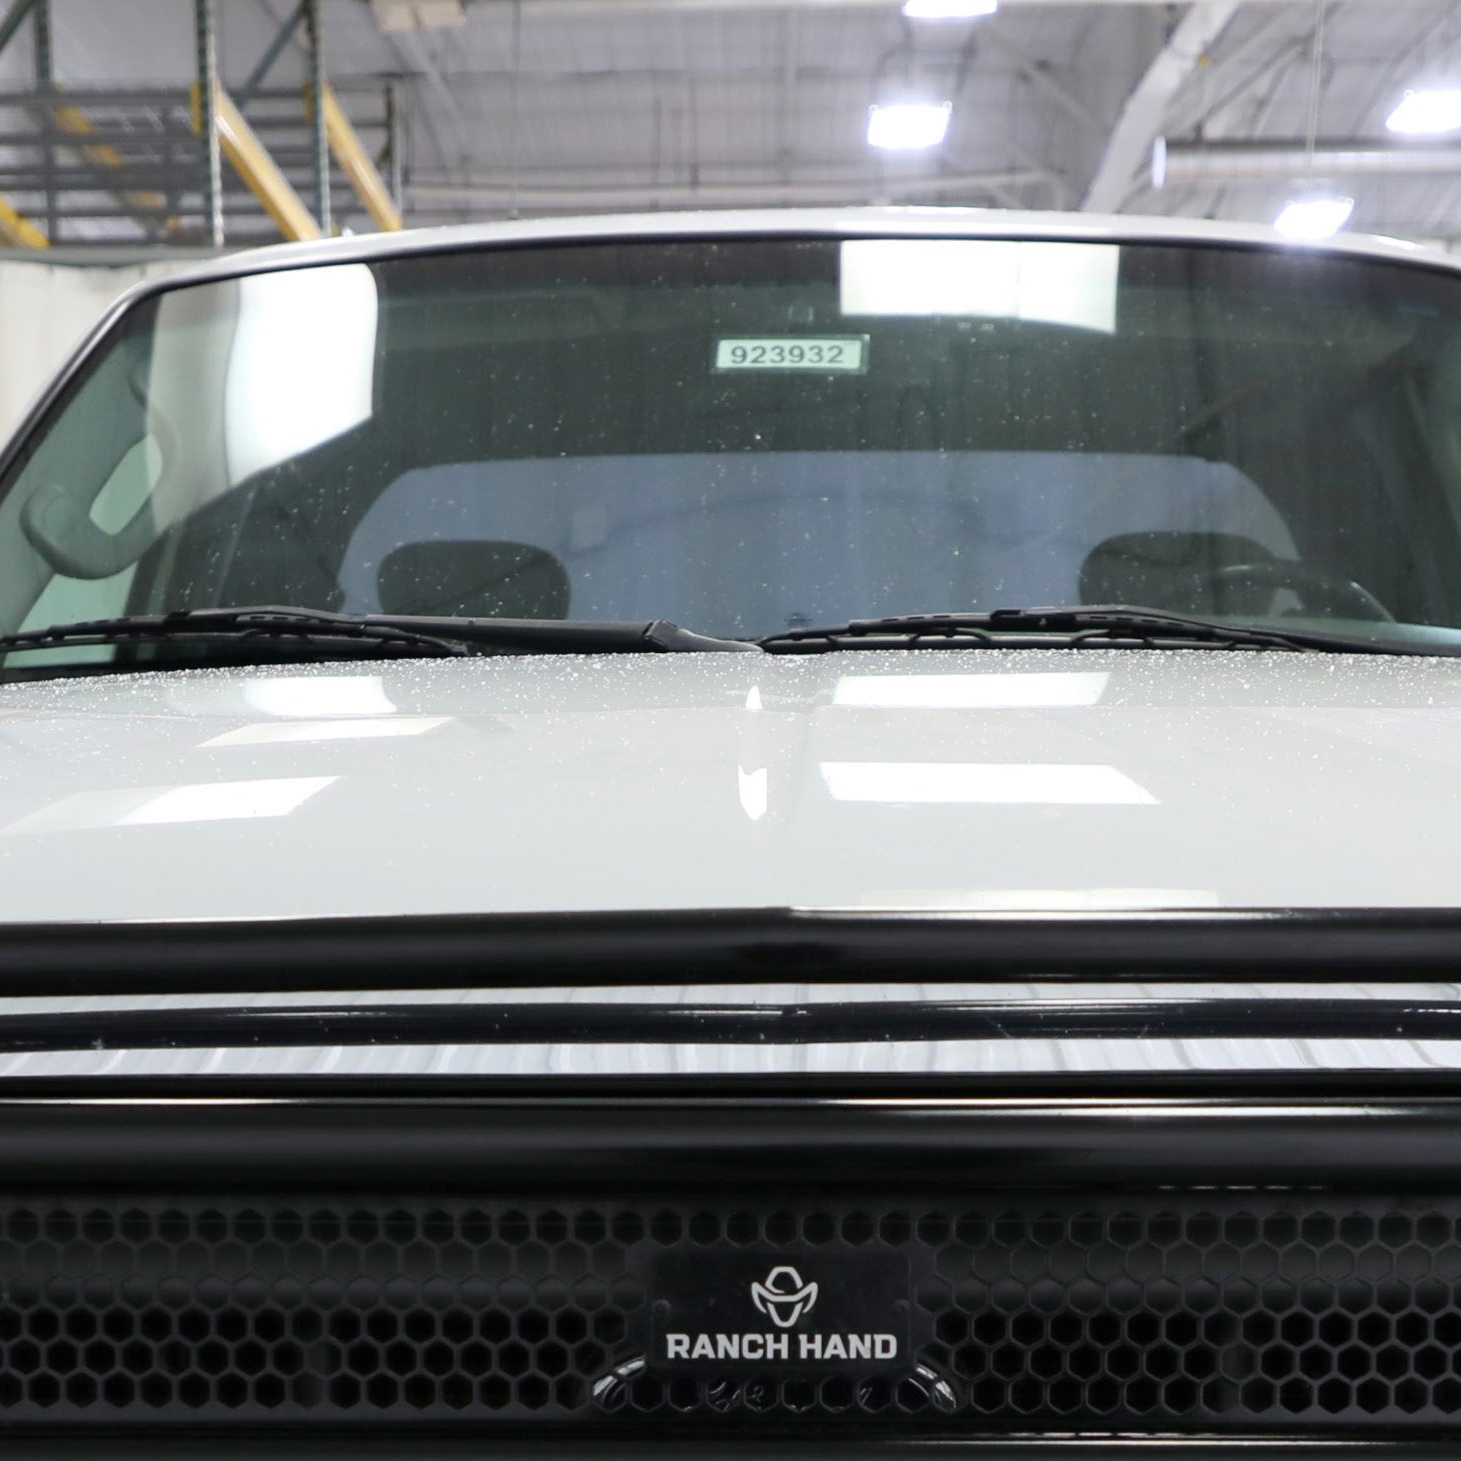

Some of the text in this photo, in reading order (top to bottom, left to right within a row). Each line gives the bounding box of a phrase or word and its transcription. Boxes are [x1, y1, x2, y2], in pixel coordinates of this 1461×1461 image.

[730, 345, 845, 365] 923932
[666, 1333, 898, 1360] RANCH HAND
